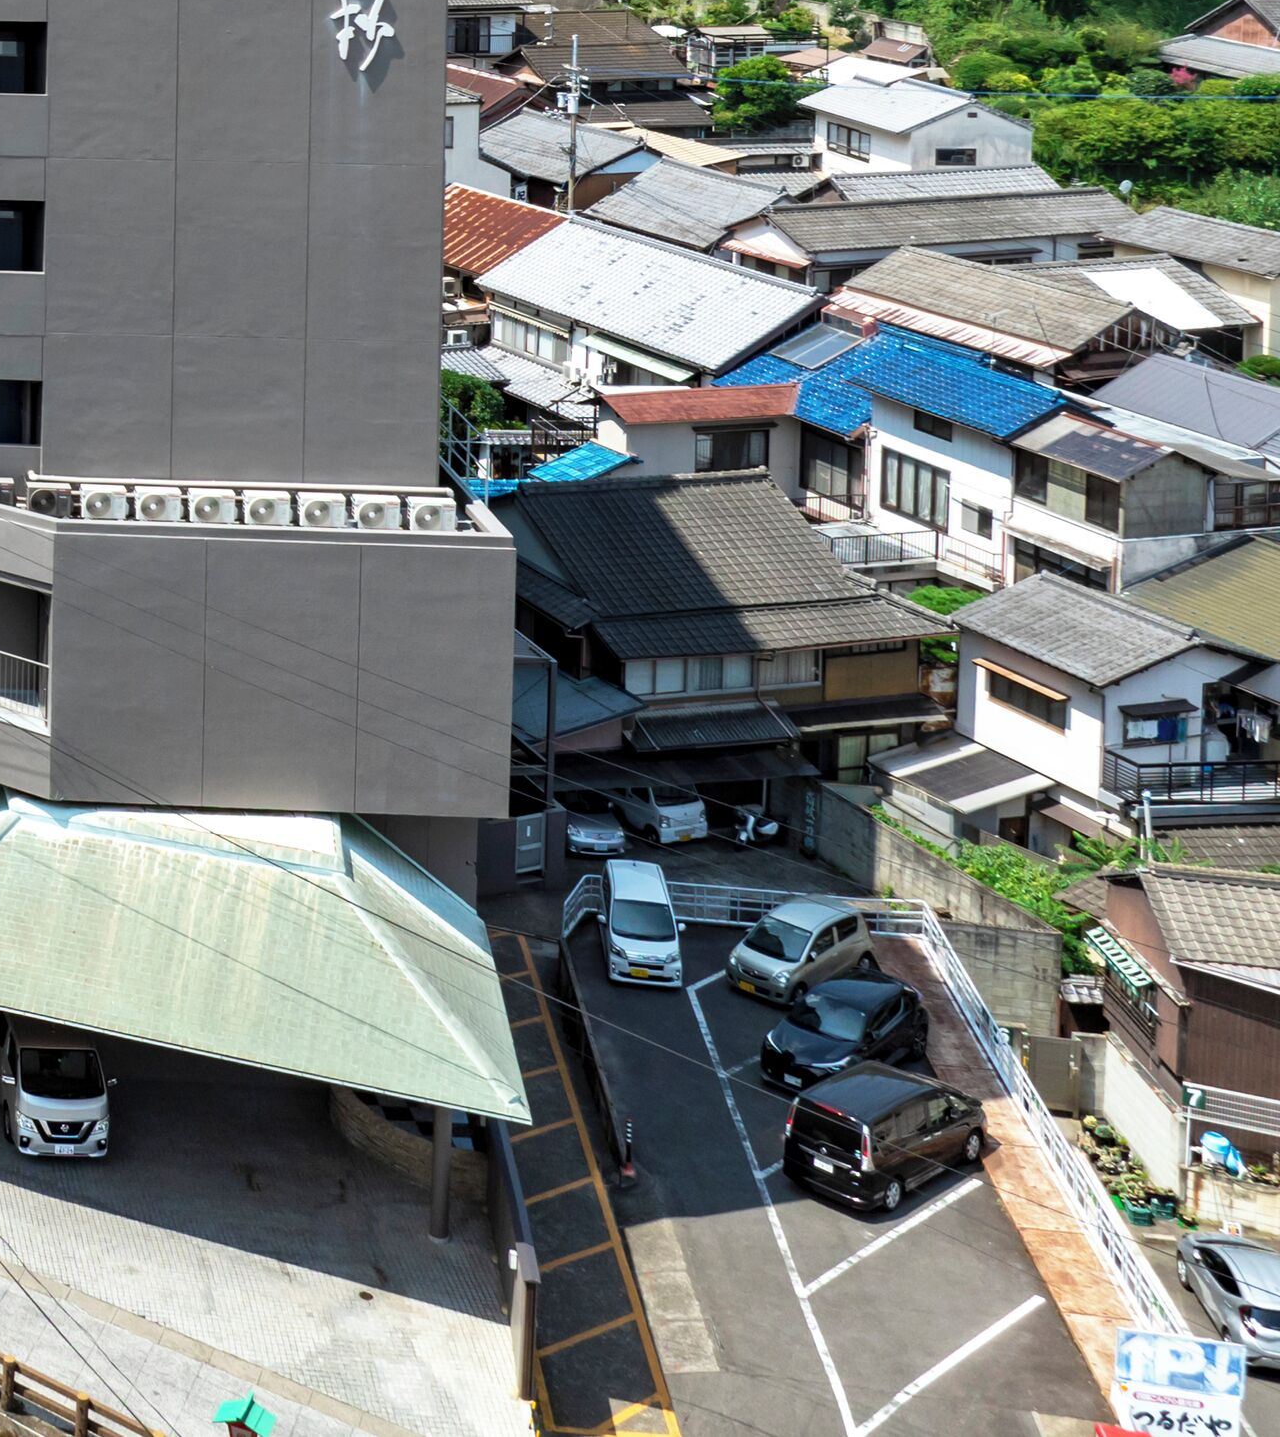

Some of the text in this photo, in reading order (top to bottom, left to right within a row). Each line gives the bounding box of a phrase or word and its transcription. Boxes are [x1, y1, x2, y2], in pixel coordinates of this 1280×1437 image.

[1186, 1087, 1202, 1107] 7
[1153, 1337, 1207, 1386] P
[1133, 1410, 1233, 1437] つるだや
